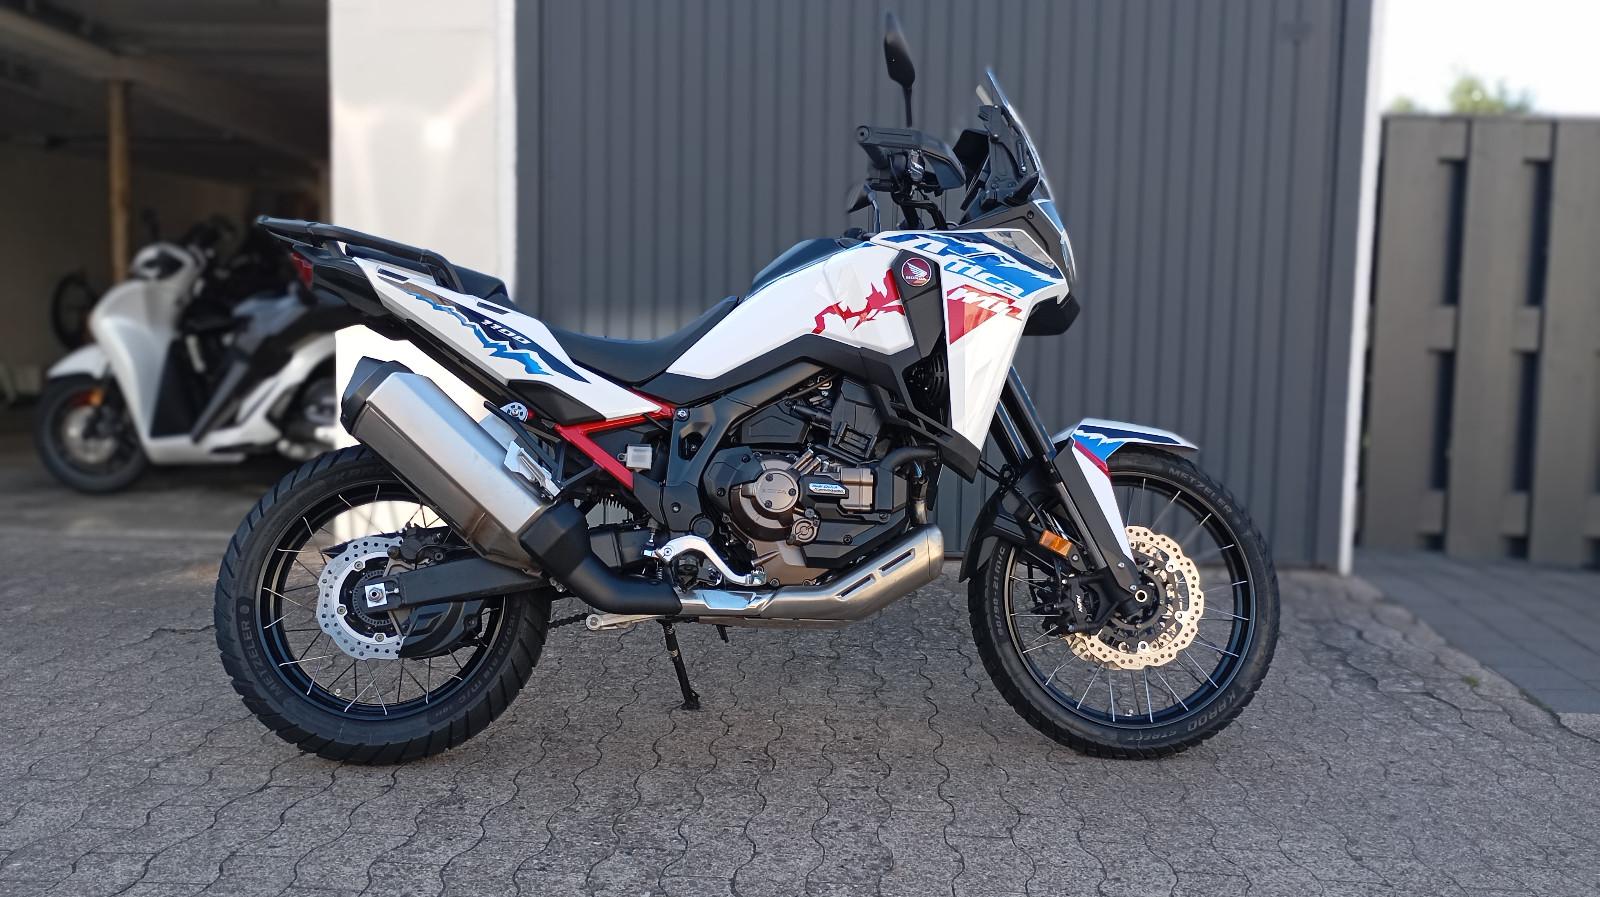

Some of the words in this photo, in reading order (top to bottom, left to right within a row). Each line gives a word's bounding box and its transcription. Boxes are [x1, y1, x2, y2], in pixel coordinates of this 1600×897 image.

[481, 319, 532, 344] 1100
[1168, 467, 1233, 512] METZELER
[240, 620, 284, 697] METZELER
[1187, 690, 1236, 732] KAROO
